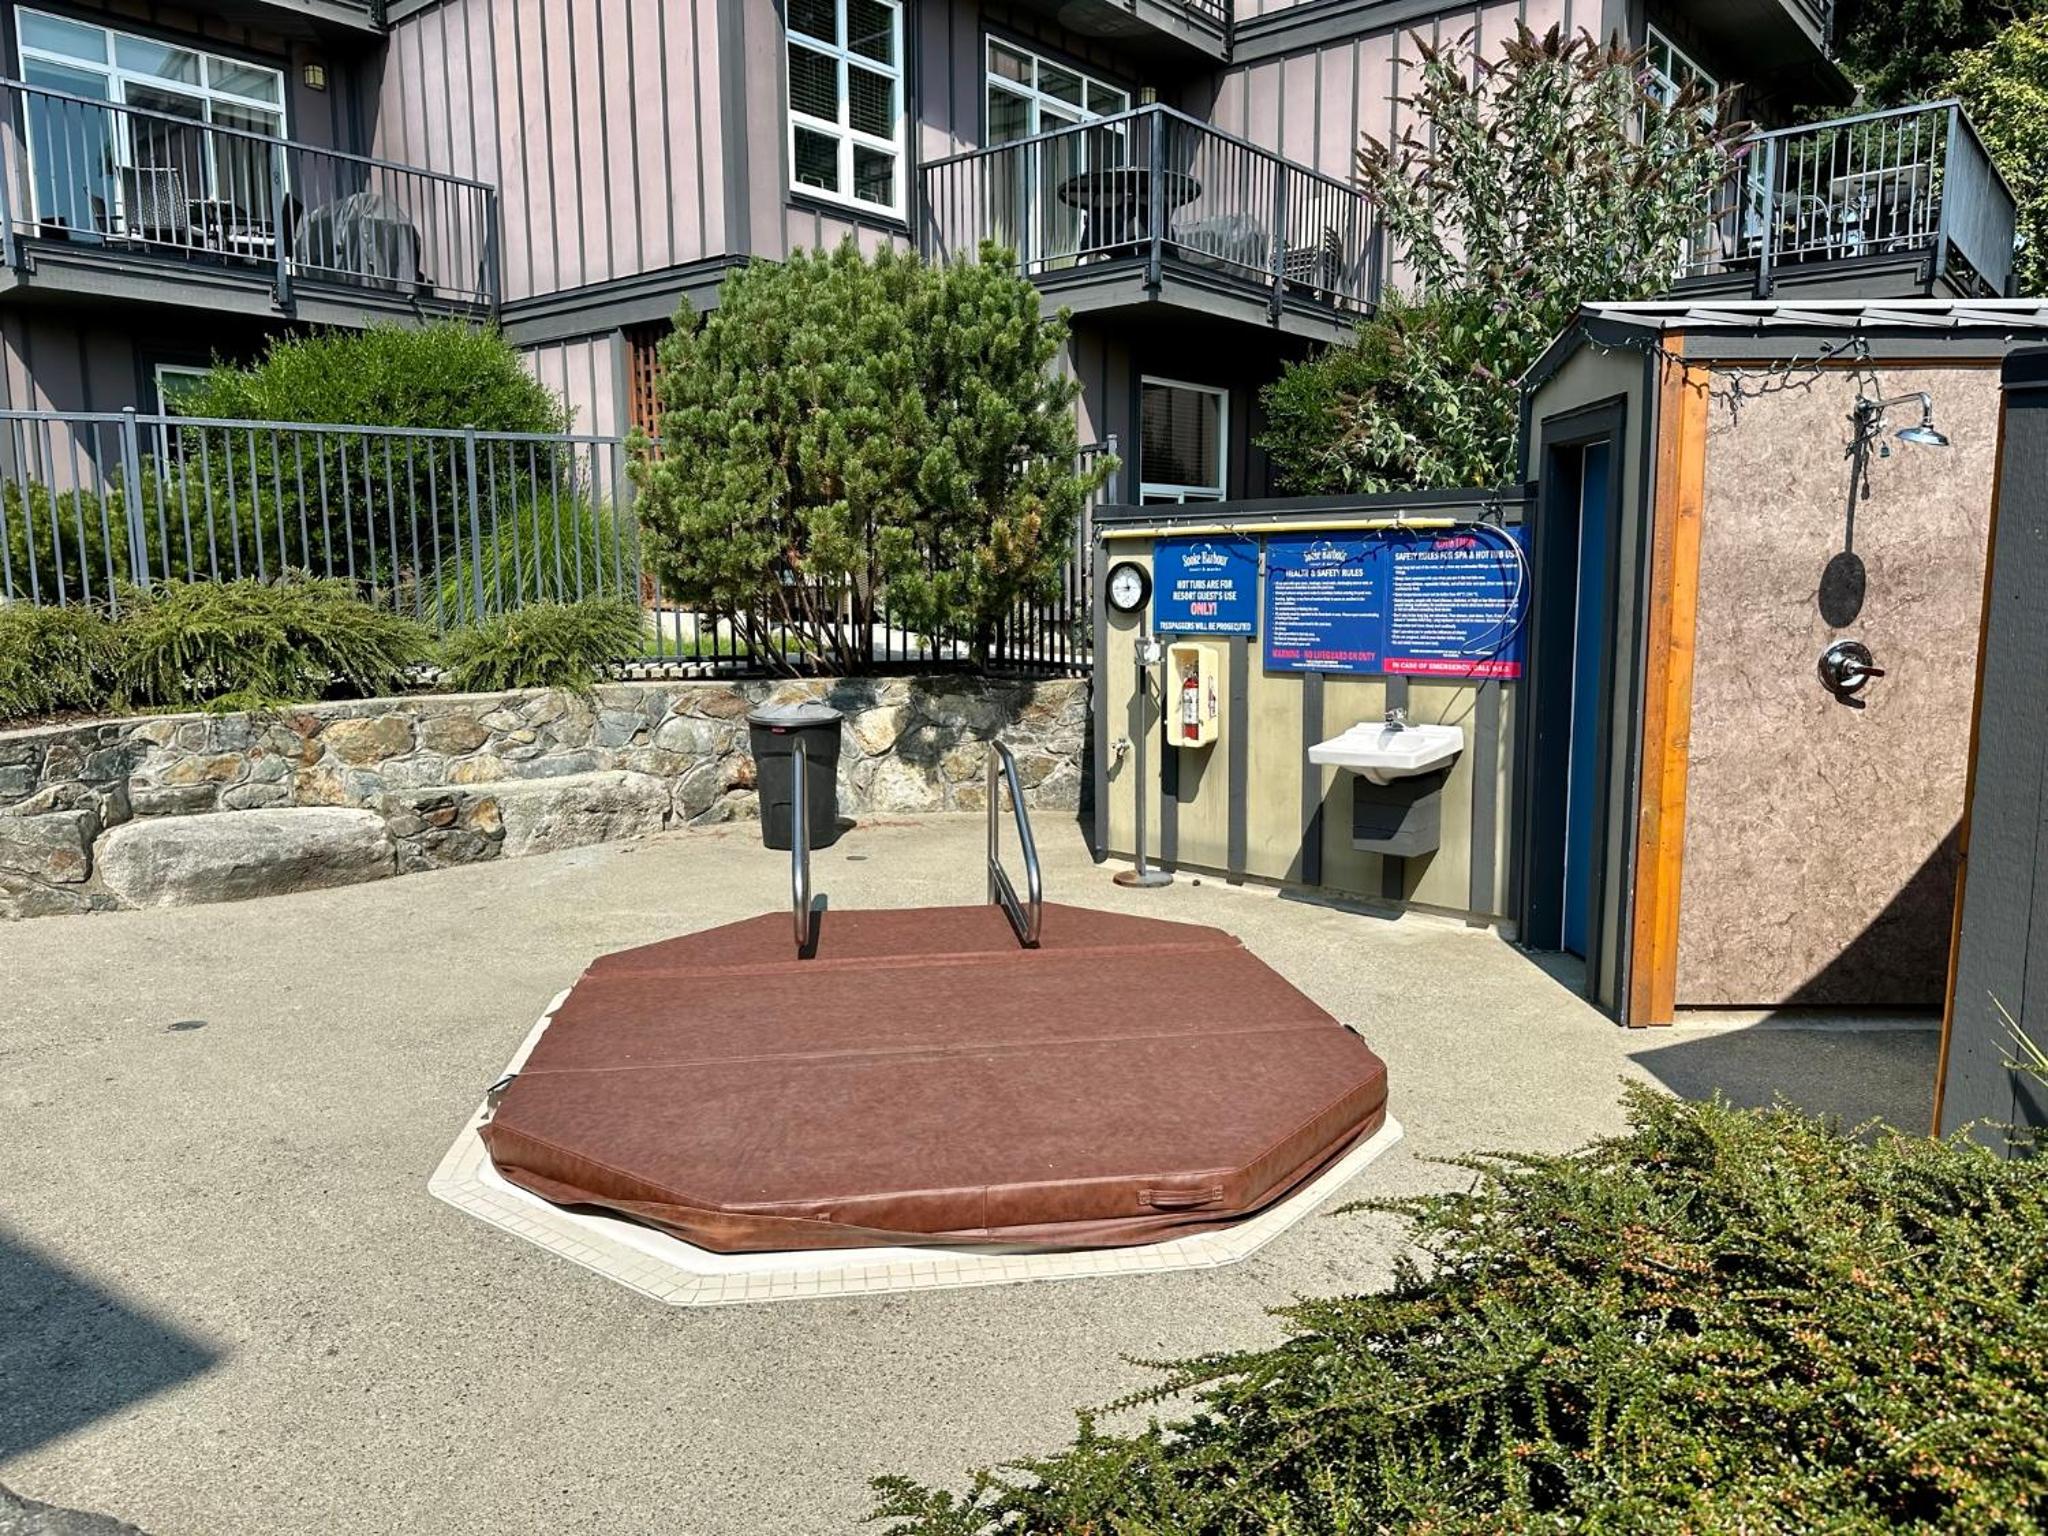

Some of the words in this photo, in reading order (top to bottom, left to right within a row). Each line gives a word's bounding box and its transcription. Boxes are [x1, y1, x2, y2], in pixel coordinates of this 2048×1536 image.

[1395, 551, 1417, 561] SAFETY
[1418, 551, 1439, 561] RULES
[1454, 550, 1468, 559] SPA
[1475, 549, 1490, 559] HOT
[1317, 568, 1341, 577] SAFETY
[1342, 567, 1364, 577] RULES
[1207, 579, 1220, 590] ARE
[1220, 579, 1233, 590] FOR
[1172, 591, 1197, 601] RESORT
[1224, 591, 1237, 601] USE
[1190, 602, 1218, 616] ONLY!
[1194, 621, 1208, 631] WILL
[1208, 621, 1216, 631] BE
